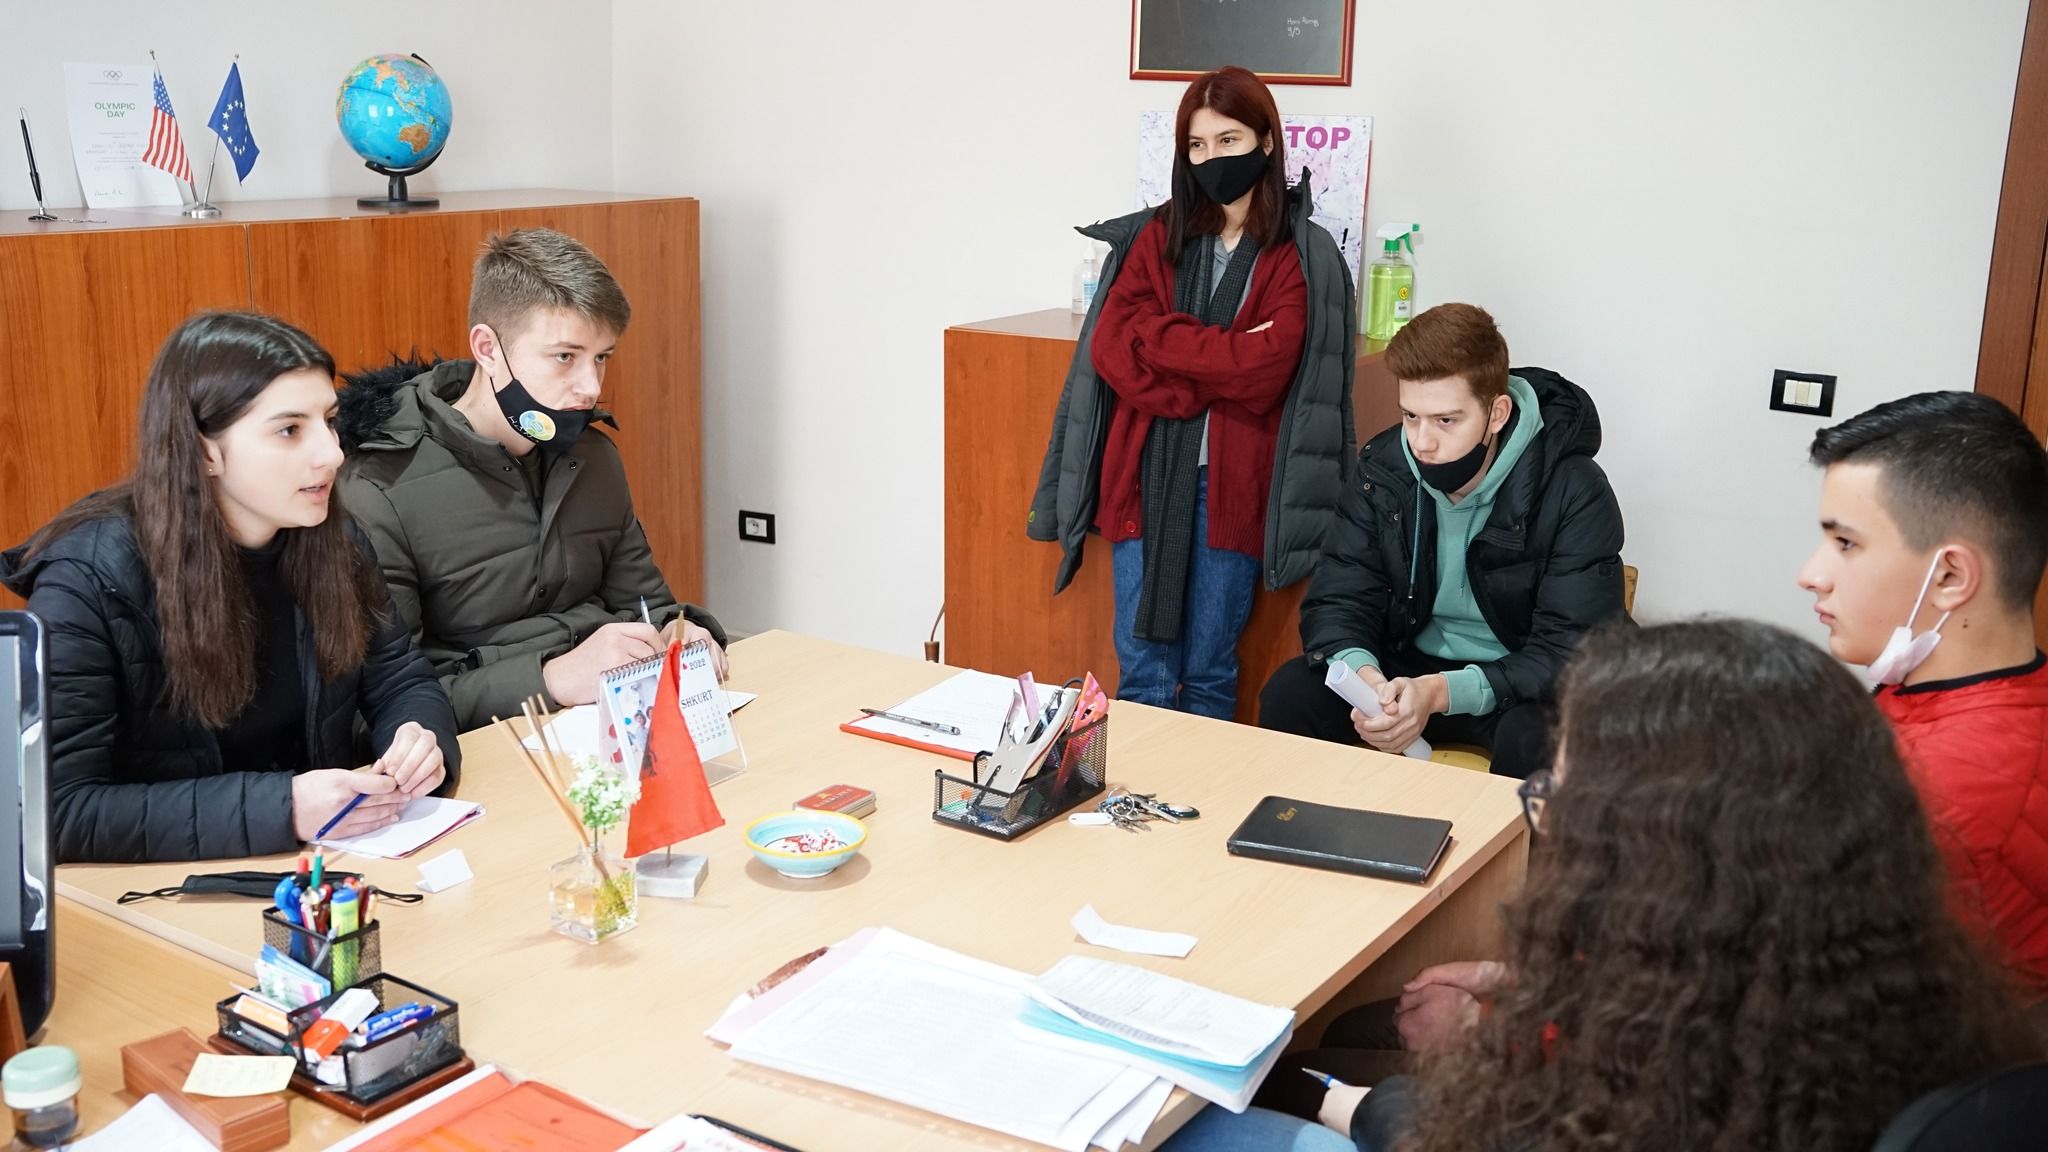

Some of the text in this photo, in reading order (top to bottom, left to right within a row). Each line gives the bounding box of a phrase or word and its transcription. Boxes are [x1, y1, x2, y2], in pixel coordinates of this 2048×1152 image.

[94, 102, 136, 110] OLYMPIC
[107, 110, 125, 118] DAY
[689, 658, 706, 670] 2022
[681, 690, 713, 709] SHKURT
